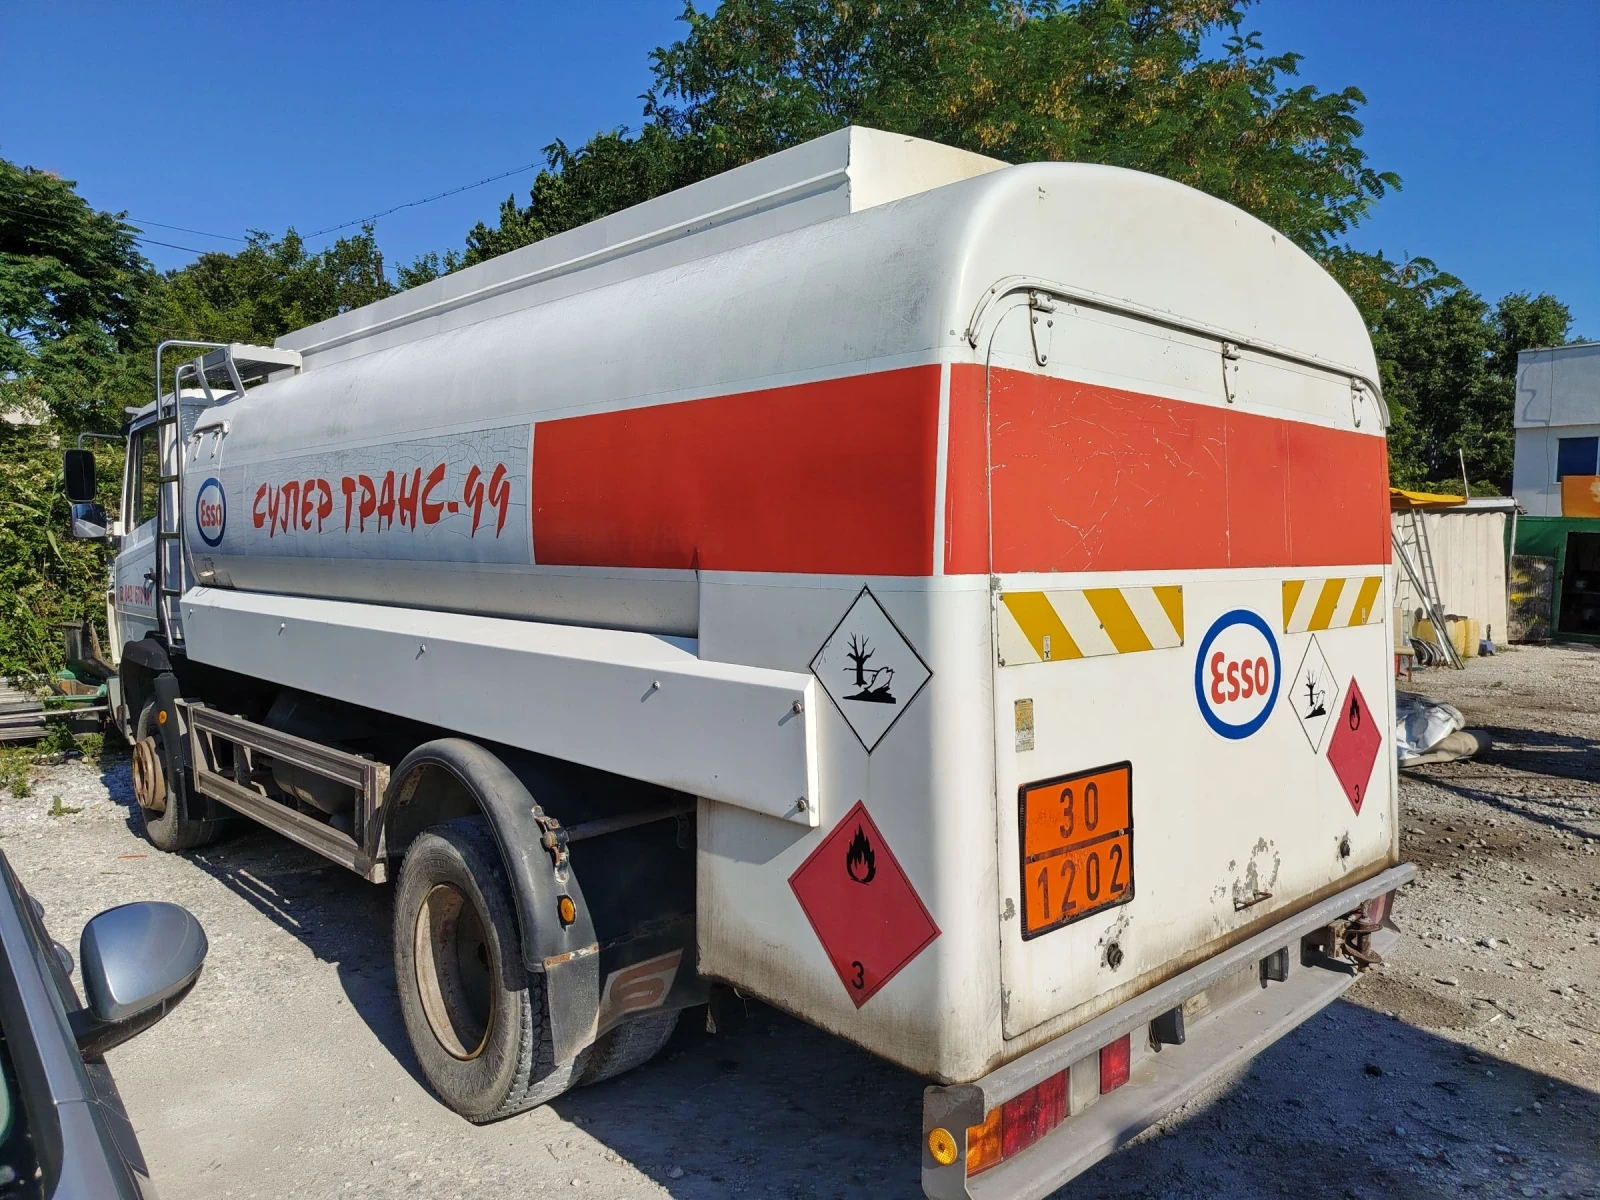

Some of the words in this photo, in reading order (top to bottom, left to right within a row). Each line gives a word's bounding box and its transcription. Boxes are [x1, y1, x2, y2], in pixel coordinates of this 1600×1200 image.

[252, 479, 333, 538] СУПЕР
[1059, 782, 1099, 838] 30
[1354, 784, 1360, 804] 3
[1037, 844, 1124, 920] 1202
[851, 960, 864, 989] 3
